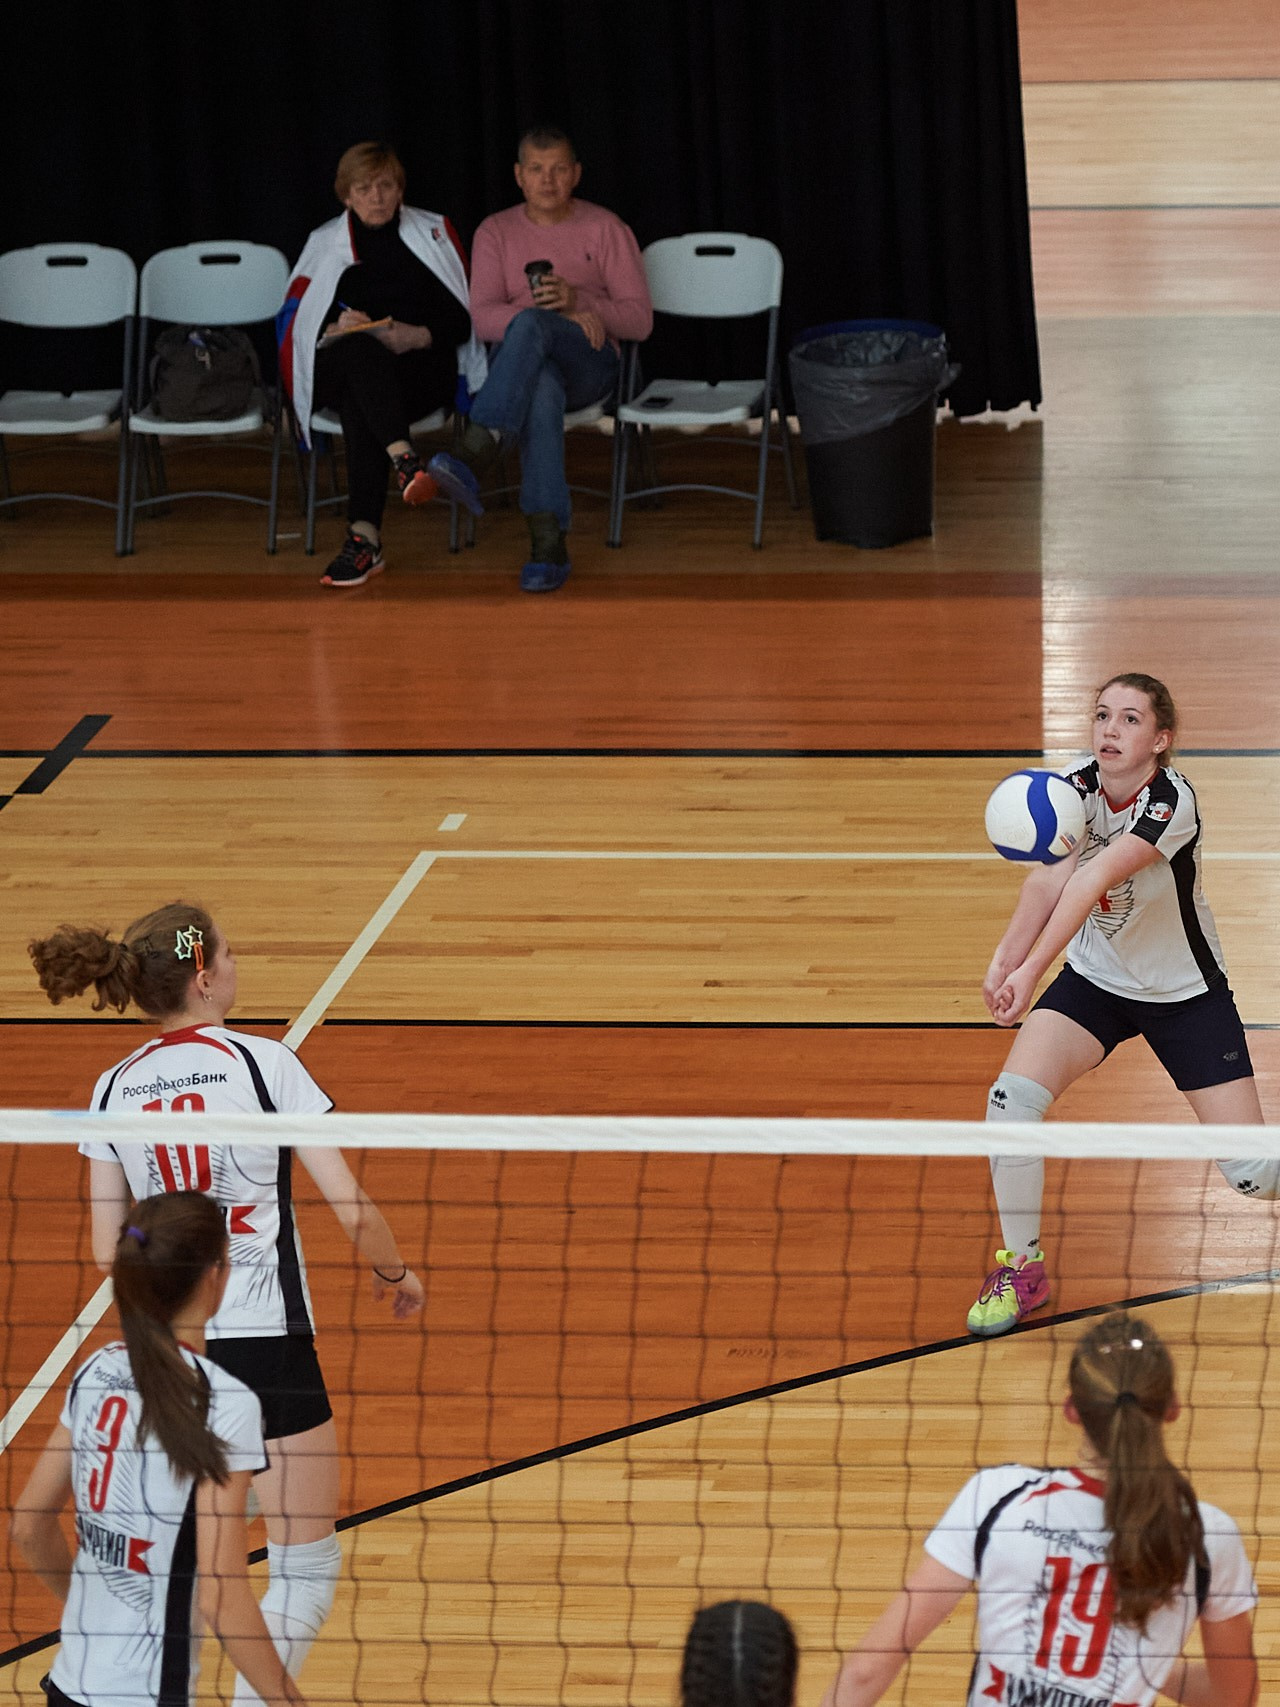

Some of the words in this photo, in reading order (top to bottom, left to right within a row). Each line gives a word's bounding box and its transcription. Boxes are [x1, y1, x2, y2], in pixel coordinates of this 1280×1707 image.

[122, 1072, 228, 1100] РоссельхозБанк
[88, 1395, 129, 1513] 3
[1034, 1555, 1118, 1680] 19
